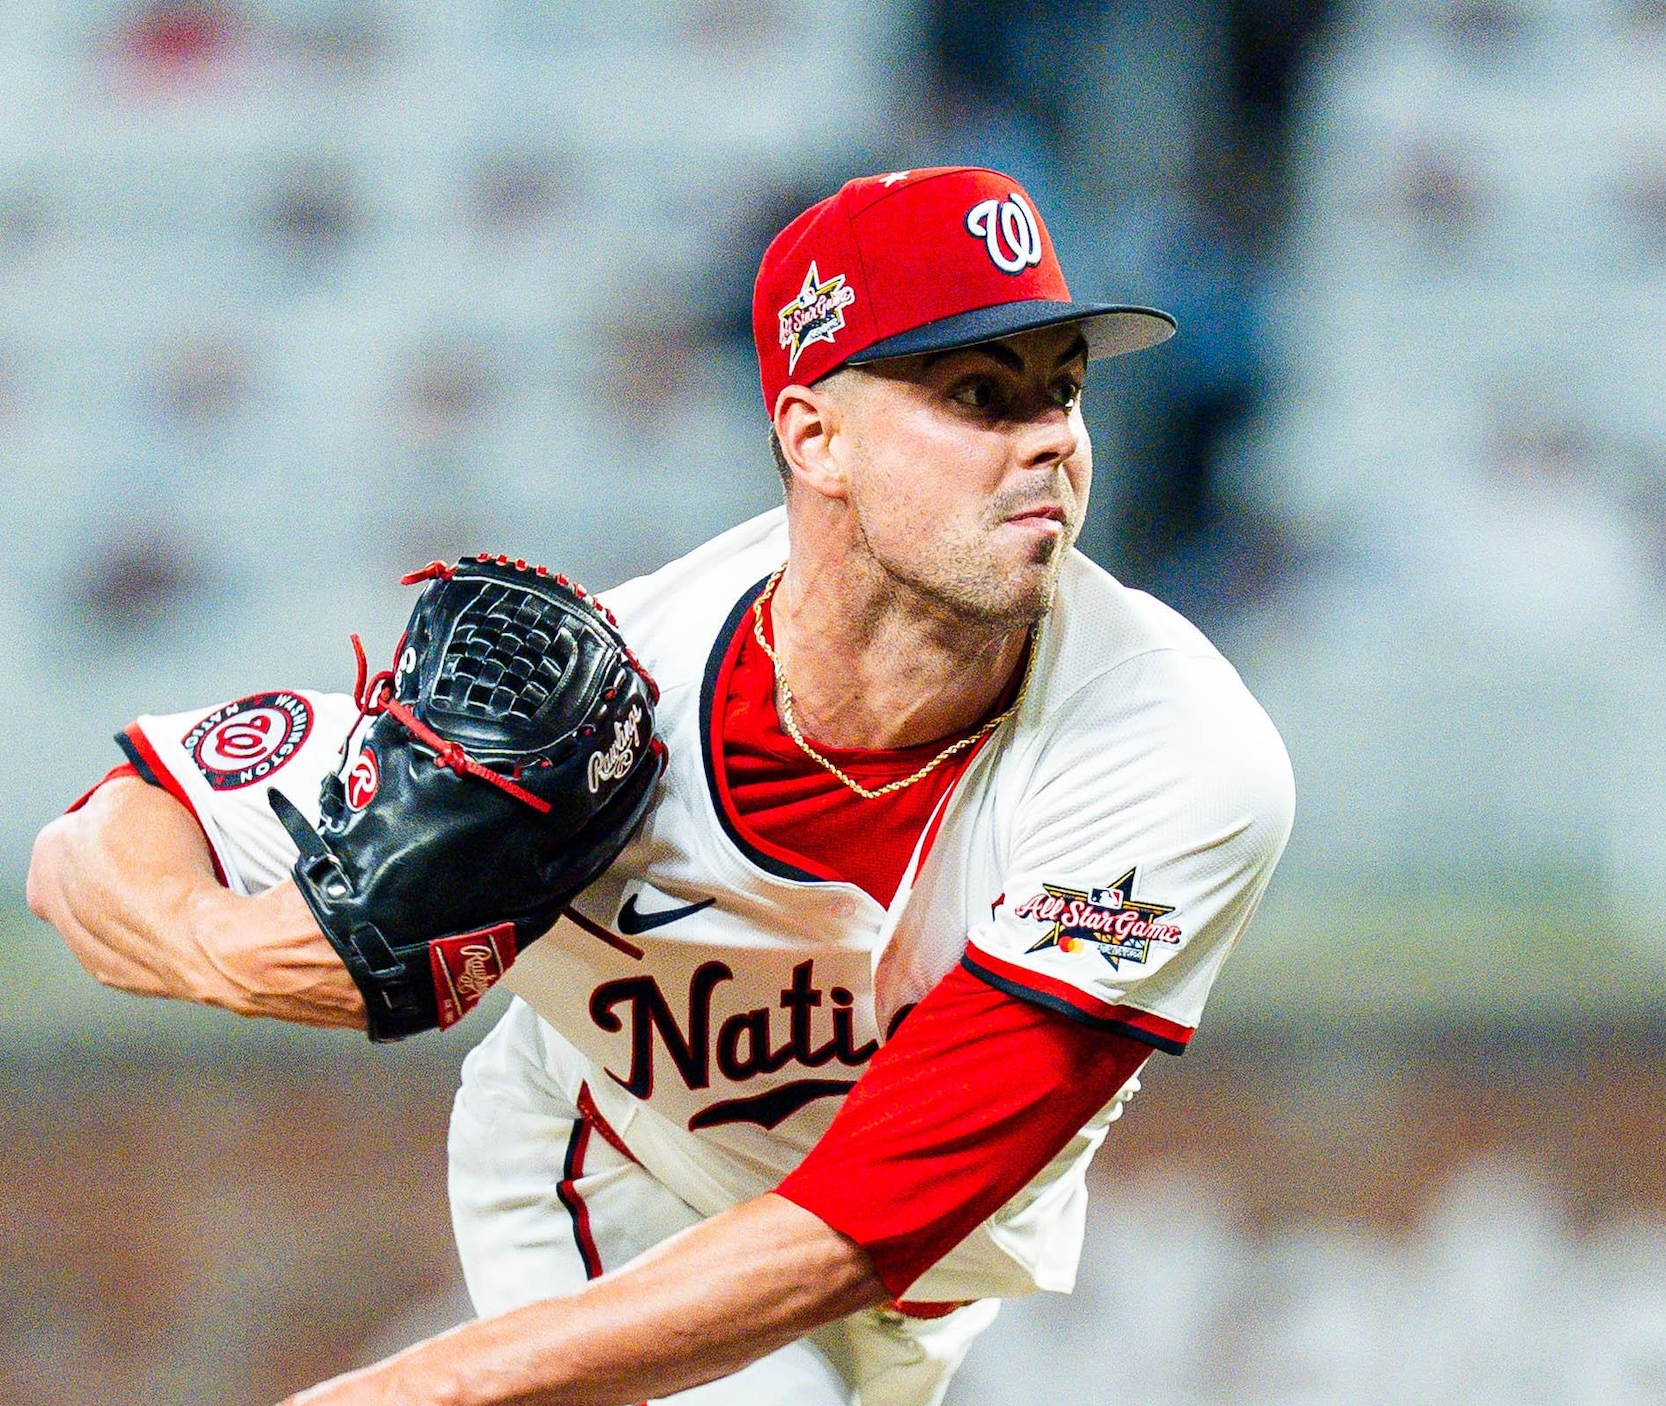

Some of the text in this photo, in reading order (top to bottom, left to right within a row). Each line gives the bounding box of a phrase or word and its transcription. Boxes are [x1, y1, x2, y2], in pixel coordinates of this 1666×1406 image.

[965, 193, 1042, 274] W
[240, 694, 307, 784] WASHINGTON
[1015, 893, 1182, 943] All Star Game
